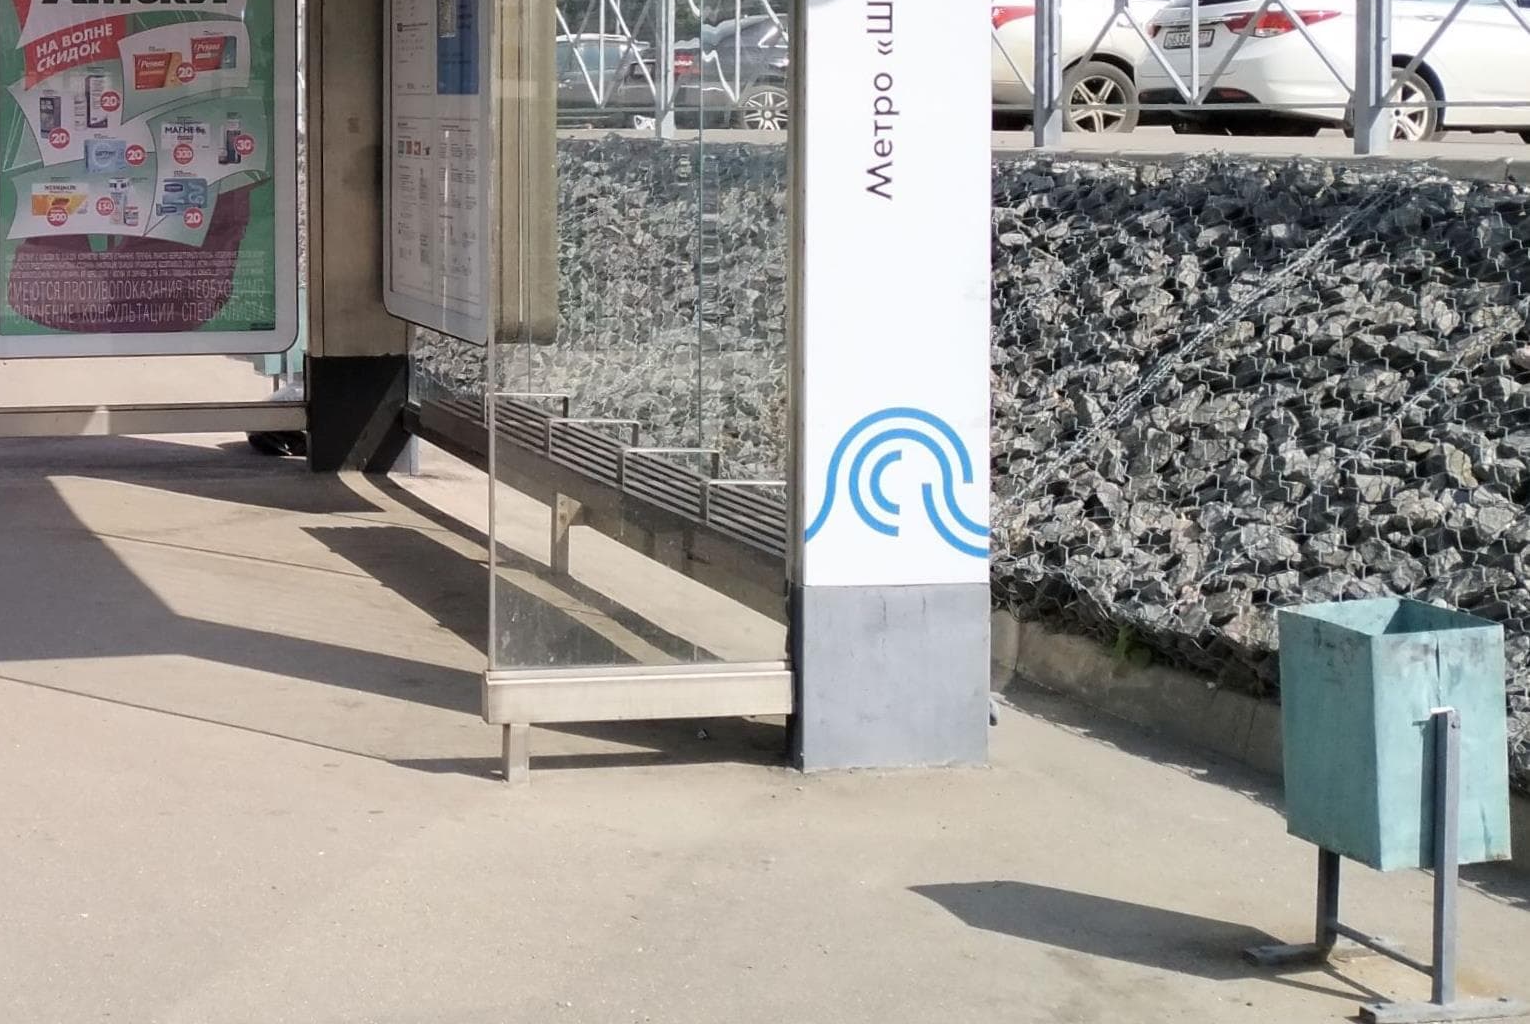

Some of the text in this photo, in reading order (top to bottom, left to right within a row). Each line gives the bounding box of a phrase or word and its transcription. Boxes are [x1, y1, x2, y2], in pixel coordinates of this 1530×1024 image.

[36, 23, 113, 58] НА ВОЛНЕ
[36, 41, 101, 73] СКИДОК
[866, 72, 899, 200] Метро
[82, 302, 174, 325] КОНСУЛЬТАЦИИ
